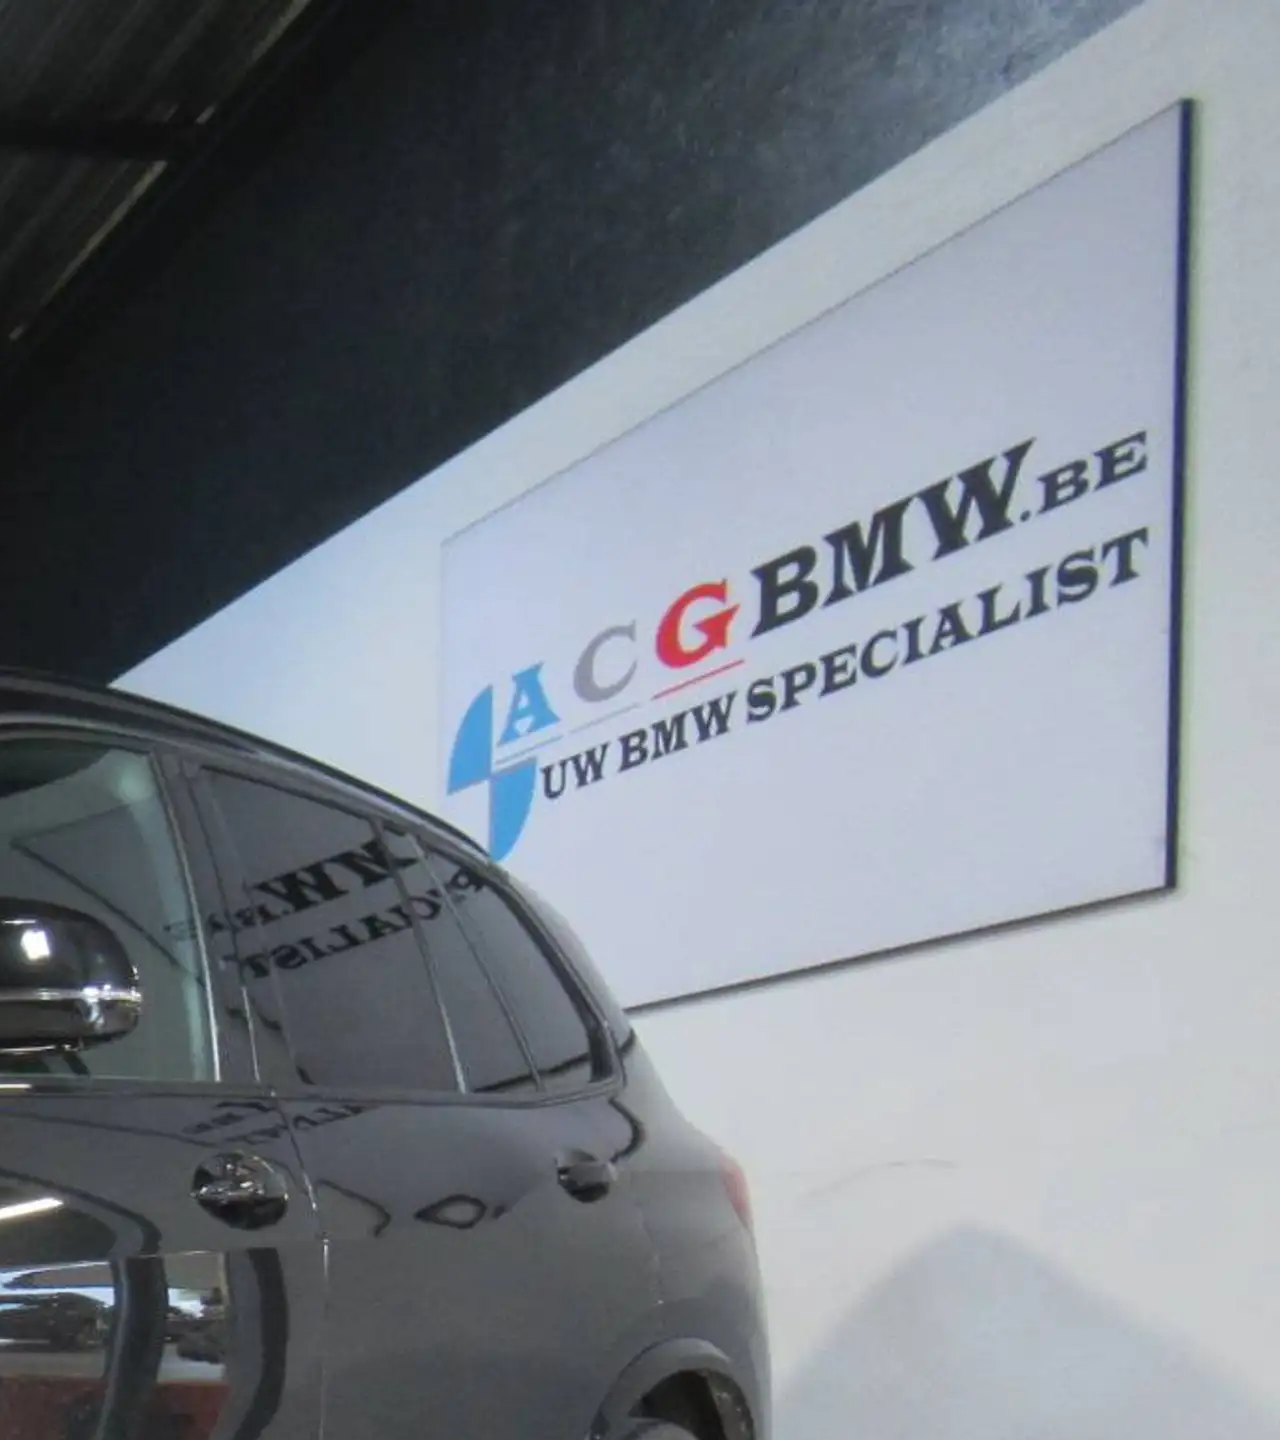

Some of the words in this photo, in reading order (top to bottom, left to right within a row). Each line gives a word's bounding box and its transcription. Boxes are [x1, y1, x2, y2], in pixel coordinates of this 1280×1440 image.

[540, 742, 611, 800] UW
[618, 691, 738, 773] BMW
[746, 527, 1149, 724] SPECIALIST
